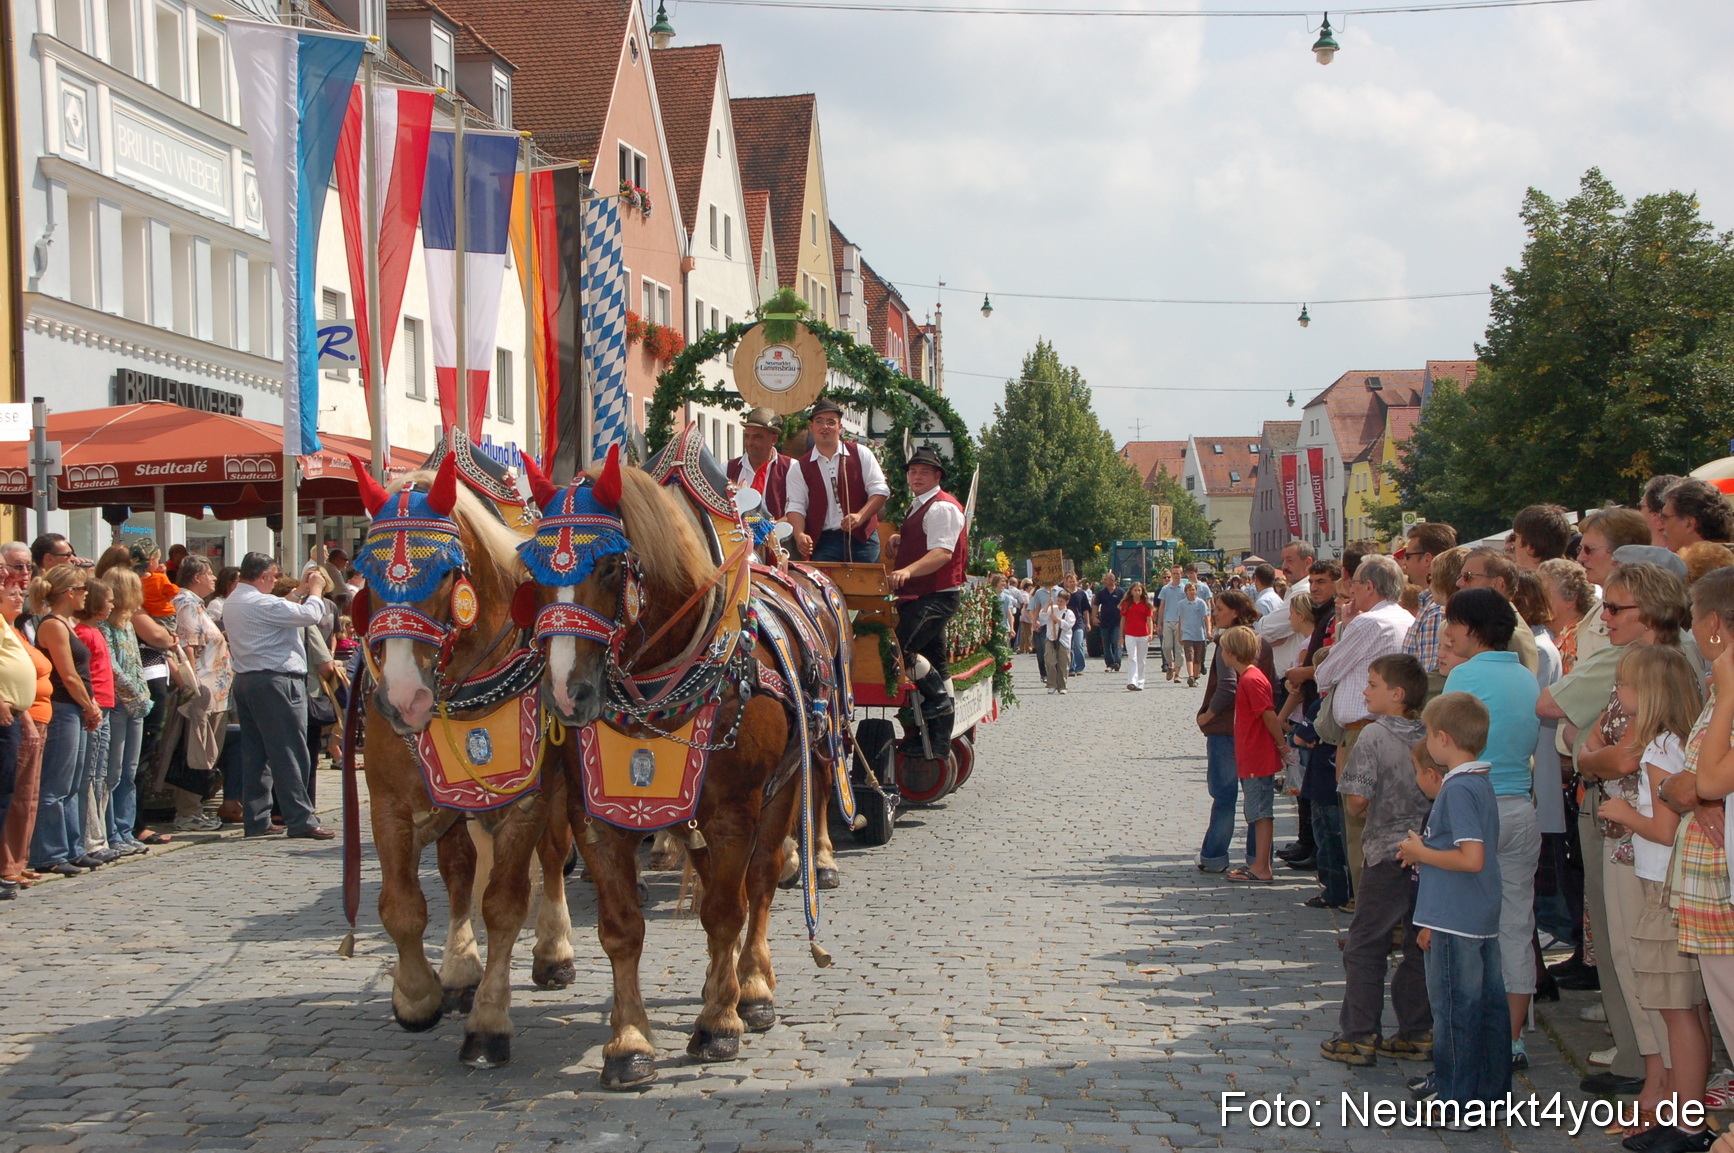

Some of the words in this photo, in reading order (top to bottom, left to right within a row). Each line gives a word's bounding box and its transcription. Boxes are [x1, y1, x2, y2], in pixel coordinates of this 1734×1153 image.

[117, 124, 172, 176] BRILLEN
[174, 149, 221, 197] WEBER
[117, 368, 188, 408] BRILLEN
[188, 383, 244, 418] WEBER
[135, 460, 208, 476] Stadtcafé
[229, 472, 277, 480] Stadtcafé
[73, 478, 120, 489] Stadtcafé
